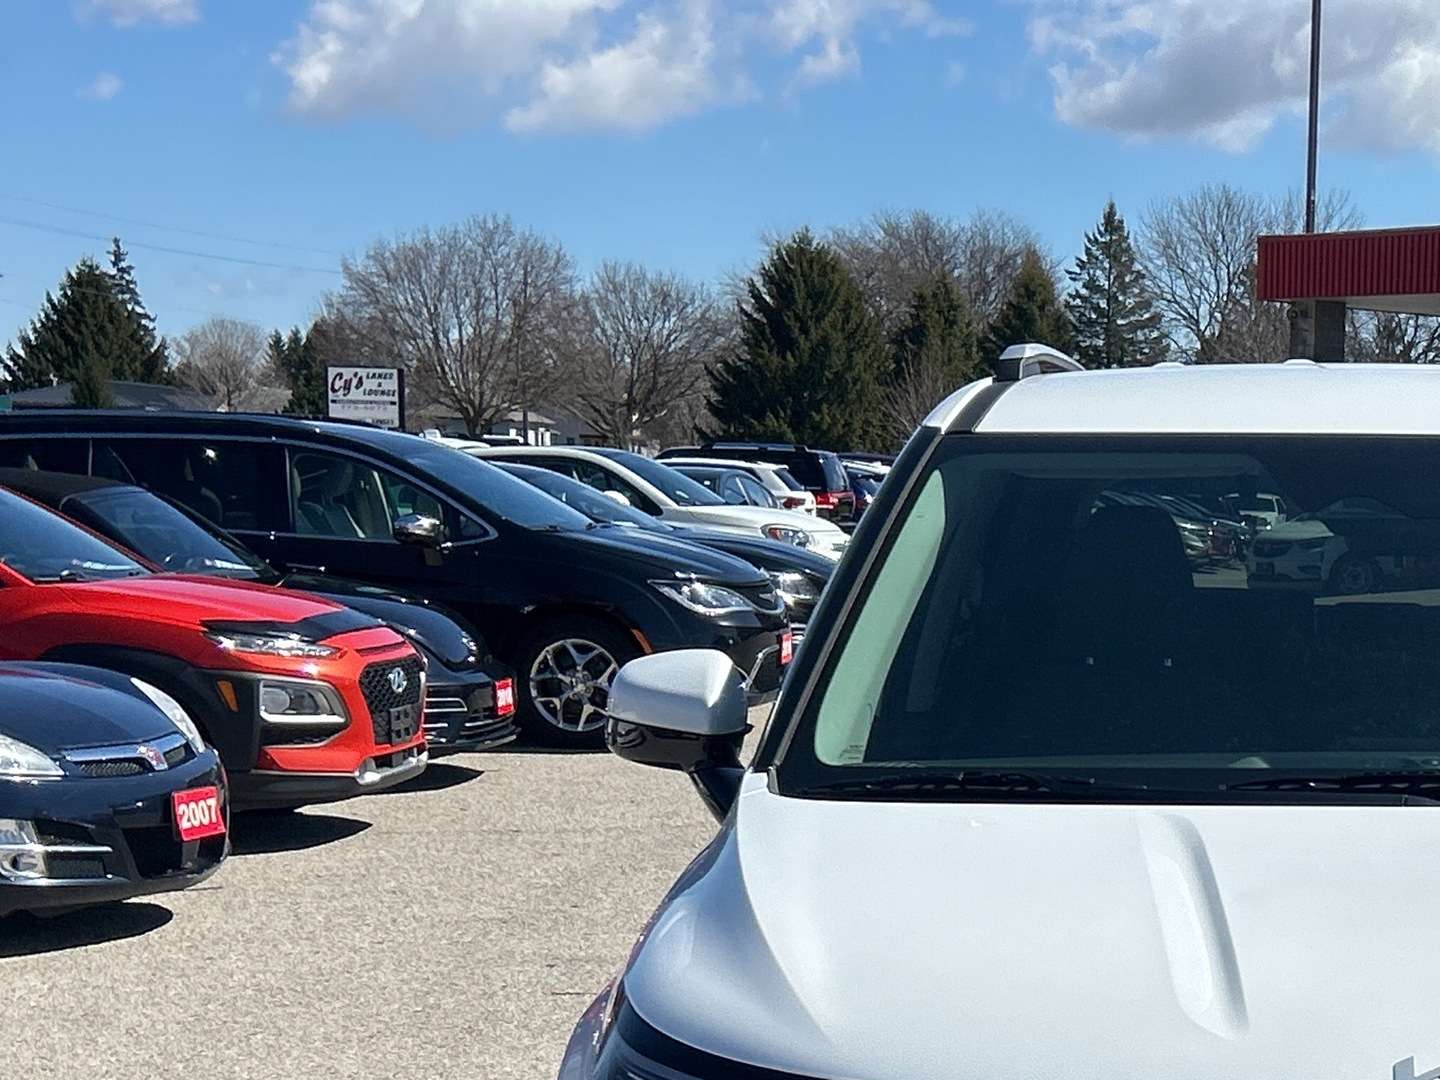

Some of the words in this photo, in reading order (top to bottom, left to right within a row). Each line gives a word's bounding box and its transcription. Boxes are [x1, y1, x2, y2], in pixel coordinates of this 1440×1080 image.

[330, 371, 364, 397] Cy's
[366, 372, 394, 380] LANES
[363, 388, 396, 397] LOUNGE
[178, 797, 218, 829] 2007
